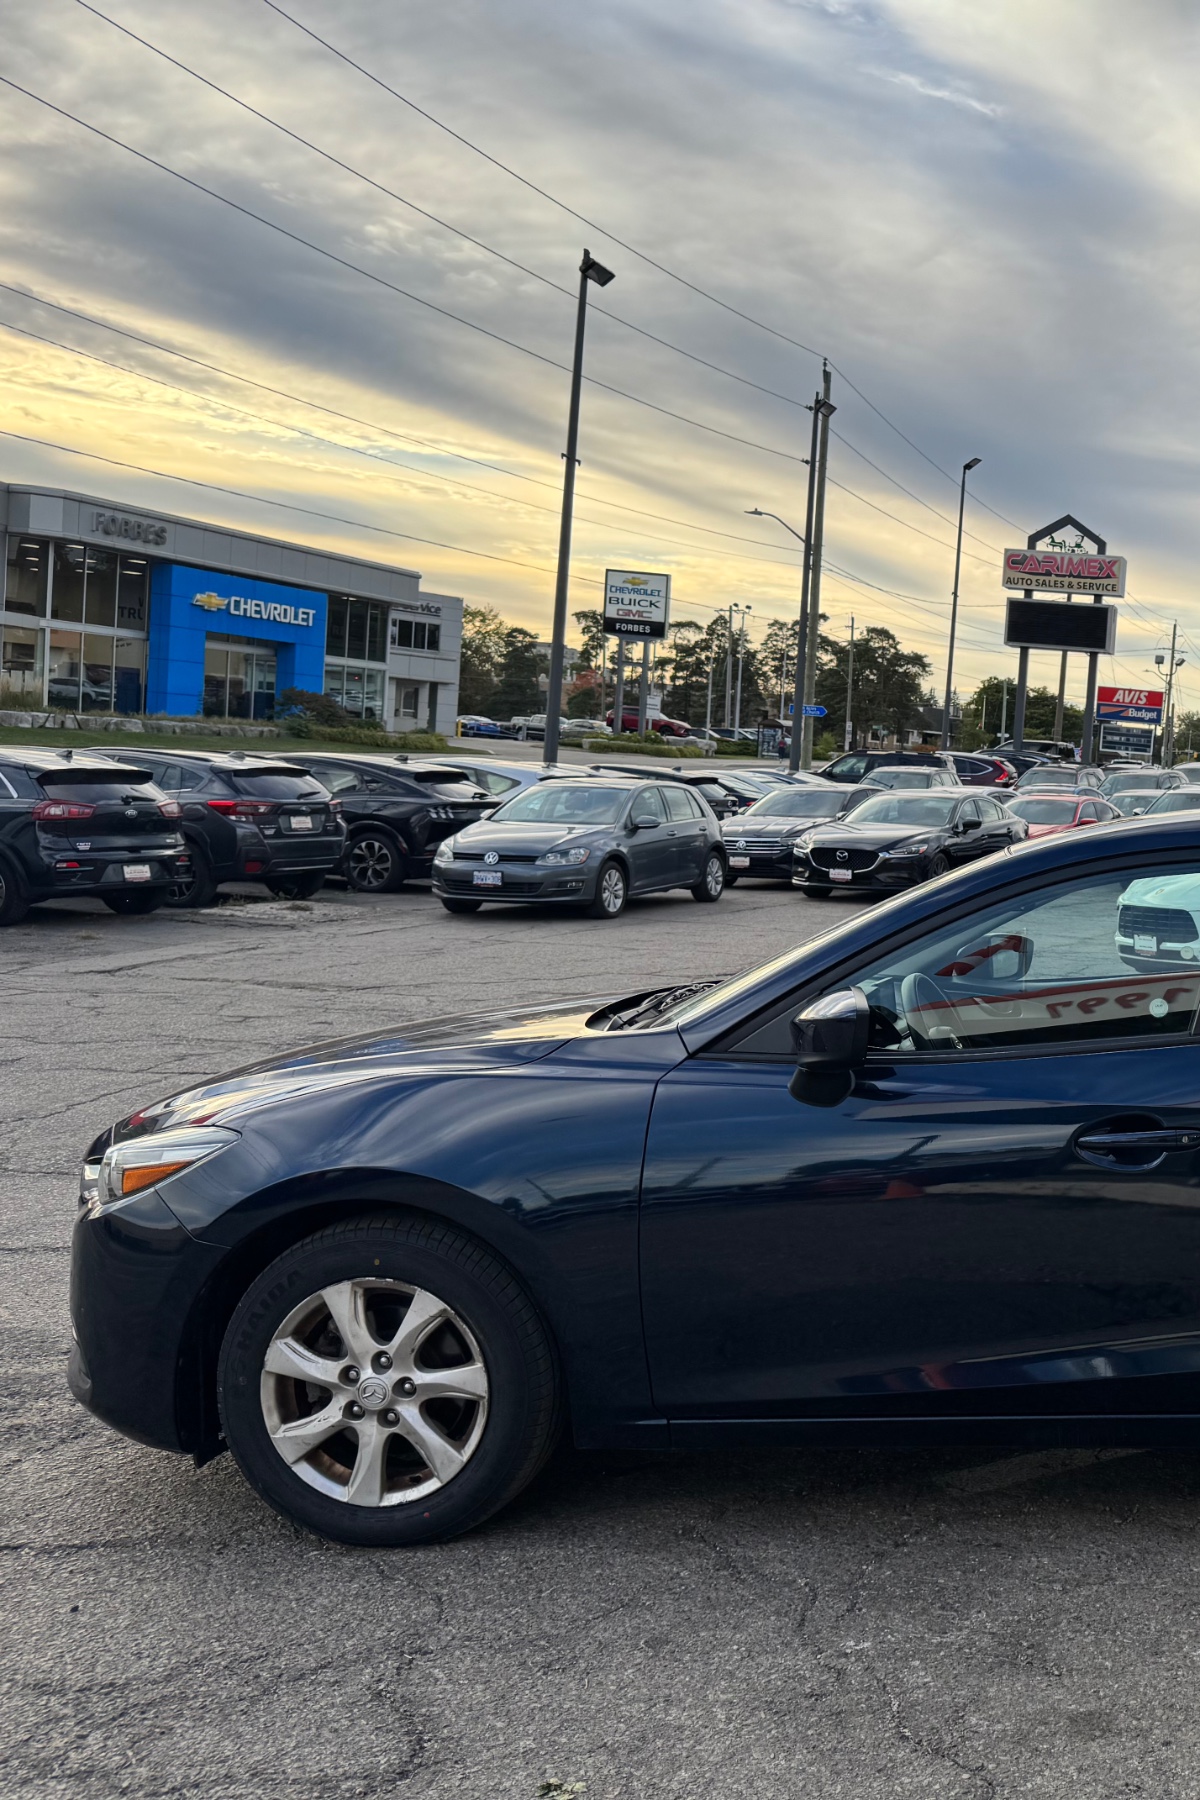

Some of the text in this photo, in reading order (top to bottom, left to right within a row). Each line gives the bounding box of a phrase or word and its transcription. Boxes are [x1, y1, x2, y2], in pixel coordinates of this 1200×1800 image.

[92, 512, 167, 545] FORBES
[1006, 553, 1121, 578] CARIMEX
[609, 585, 661, 597] CHEVROLET
[1005, 577, 1117, 592] AUTO SALES & SERVICE
[608, 596, 661, 609] BUICK
[229, 596, 316, 627] CHEVROLET
[616, 608, 652, 619] GMC
[616, 623, 651, 633] FORBES
[1112, 690, 1148, 704] AVIS
[1129, 708, 1157, 720] Budget
